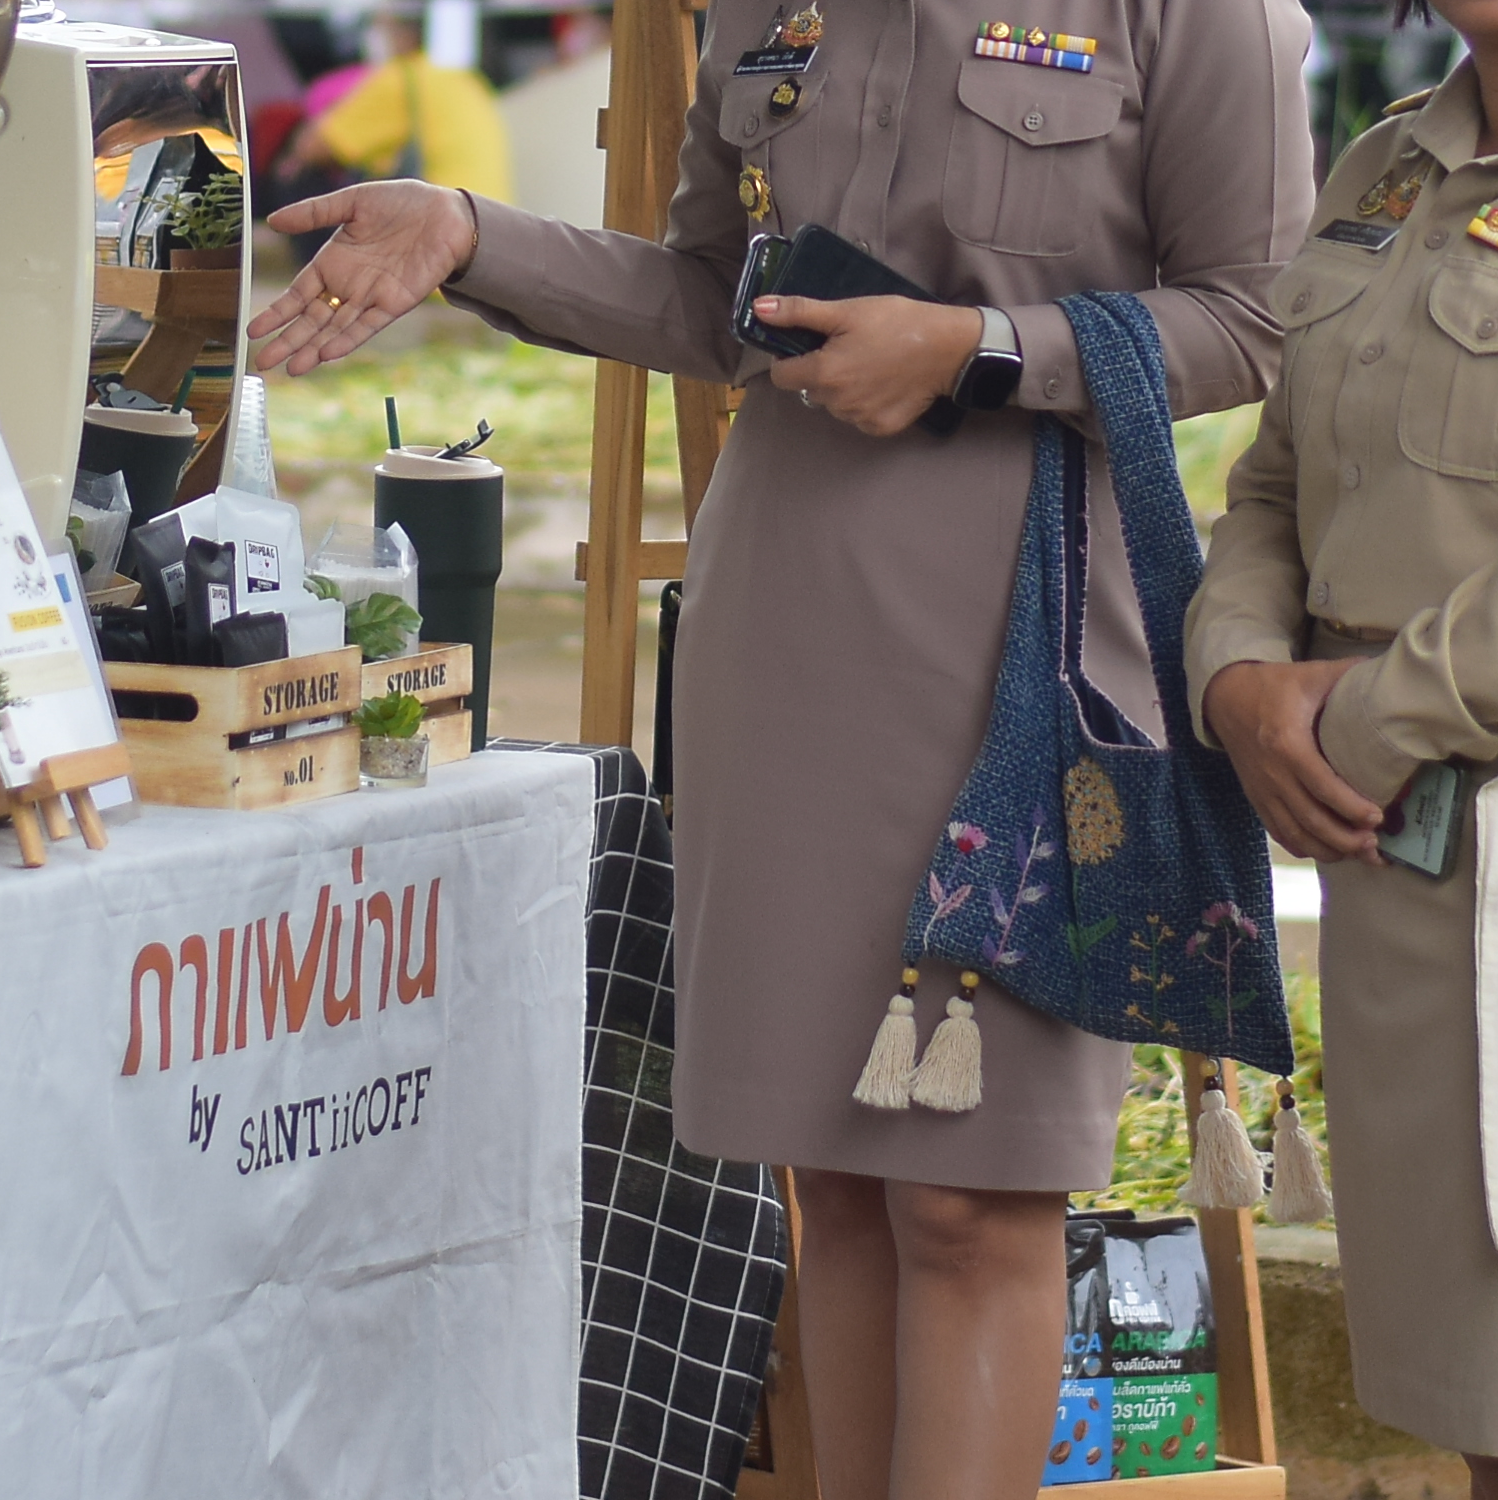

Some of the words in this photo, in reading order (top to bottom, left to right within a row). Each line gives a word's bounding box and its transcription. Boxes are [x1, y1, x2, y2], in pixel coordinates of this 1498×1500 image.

[263, 671, 339, 716] STORAGE
[387, 663, 447, 694] STORAGE
[121, 845, 441, 1077] กาแฟน่าน
[189, 1084, 222, 1153] by
[237, 1065, 432, 1176] SANTiiCOFF
[1111, 1356, 1182, 1372] องดีเมืองน่าน
[1112, 1377, 1192, 1397] มล็ดกาแฟแท้คั่ว
